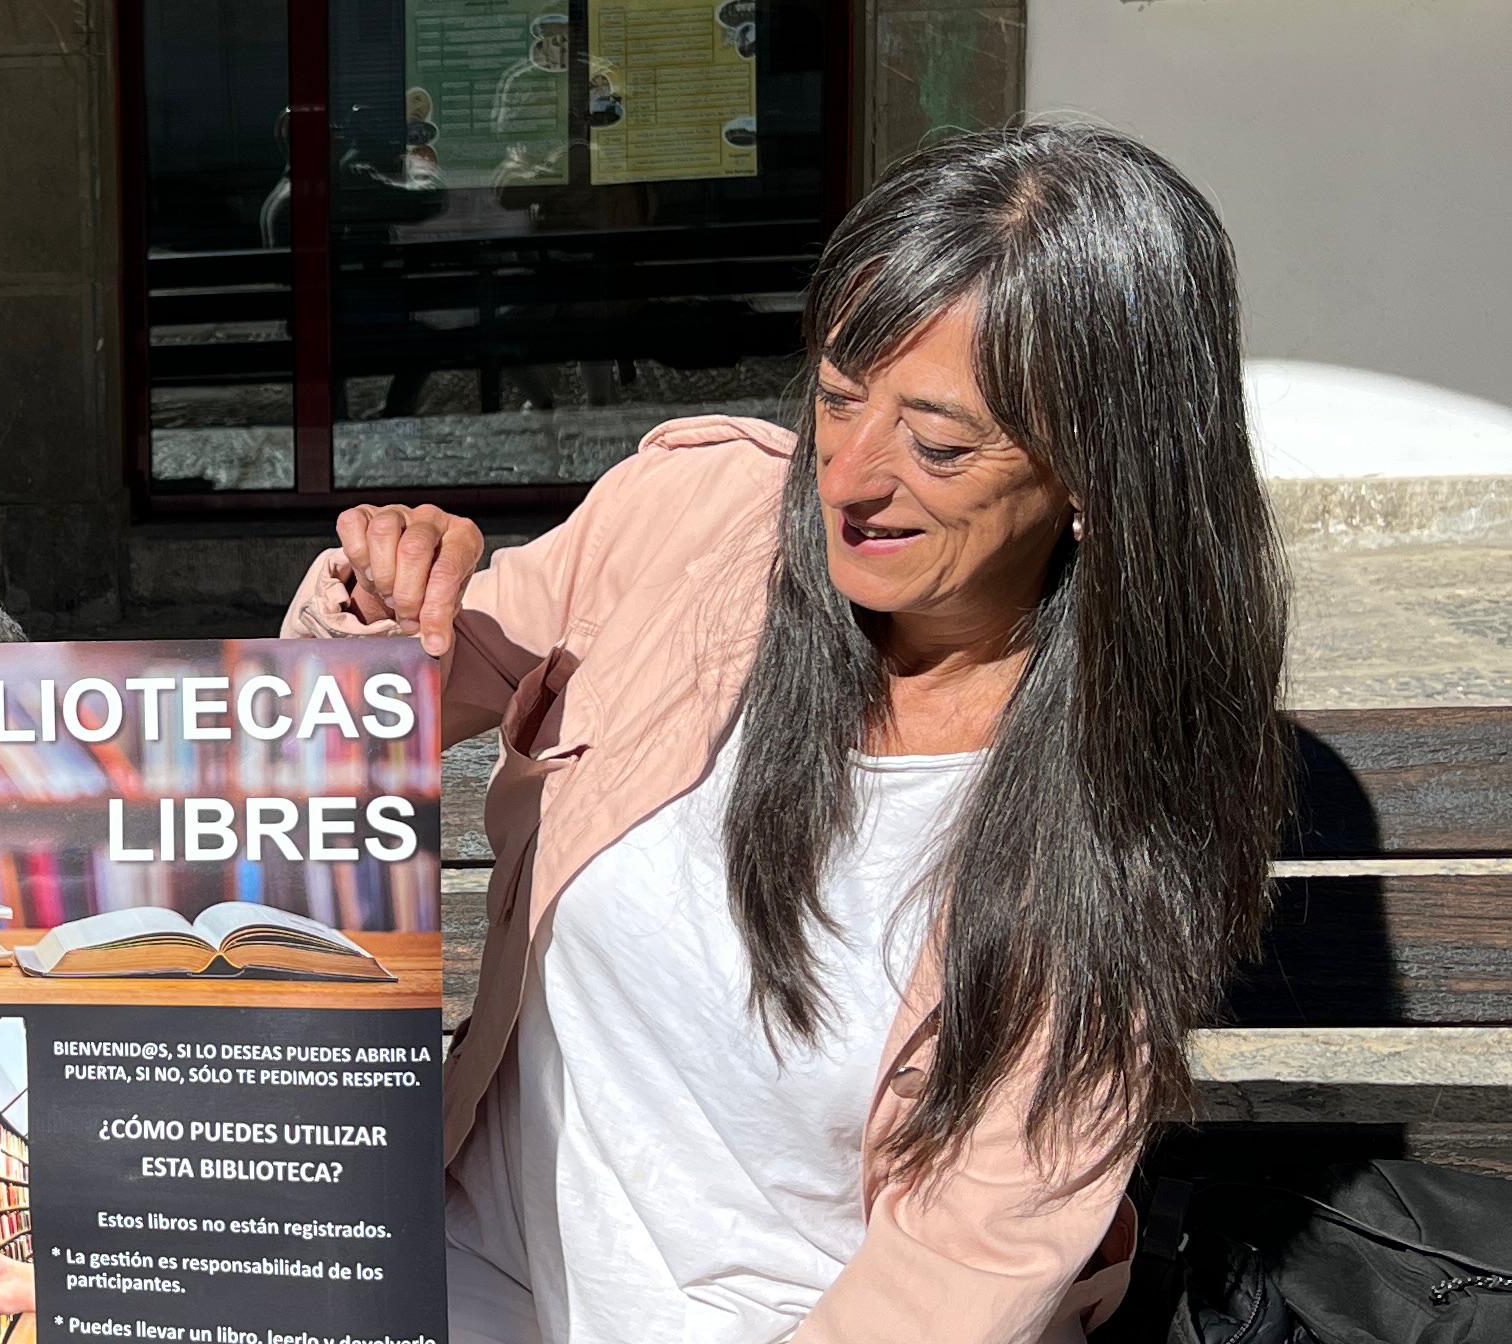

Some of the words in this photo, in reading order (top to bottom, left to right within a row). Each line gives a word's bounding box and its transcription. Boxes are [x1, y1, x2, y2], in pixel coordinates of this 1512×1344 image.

[107, 794, 419, 863] LIBRES
[53, 1040, 174, 1062] BIENVENID@S,
[176, 1042, 192, 1059] SI
[195, 1043, 218, 1060] LO
[220, 1043, 283, 1062] DESEAS
[285, 1045, 352, 1064] PUEDES
[354, 1047, 408, 1064] ABRIR
[410, 1046, 432, 1063] LA
[64, 1064, 133, 1085] PUERTA,
[135, 1065, 151, 1082] SI
[153, 1065, 186, 1086] NO,
[188, 1063, 234, 1085] SÓLO
[235, 1068, 257, 1085] TE
[259, 1069, 339, 1088] PEDIMOS
[341, 1070, 421, 1088] RESPETO.
[98, 1113, 185, 1142] ¿CÓMO
[189, 1120, 279, 1145] PUEDES
[283, 1123, 388, 1147] UTILIZAR
[141, 1156, 195, 1179] ESTA
[199, 1158, 344, 1184] BIBLIOTECA?
[97, 1211, 145, 1230] Estos
[147, 1212, 199, 1232] libros
[201, 1218, 226, 1233] no
[229, 1216, 280, 1235] están
[283, 1219, 392, 1241] registrados.
[65, 1248, 86, 1265] La
[89, 1250, 154, 1270] gestión
[157, 1256, 179, 1270] es
[181, 1257, 324, 1279] responsabilidad
[327, 1261, 353, 1281] de
[356, 1262, 384, 1281] los
[66, 1271, 187, 1294] participantes.
[68, 1316, 133, 1338] Puedes
[135, 1319, 186, 1341] llevar
[188, 1328, 213, 1343] un
